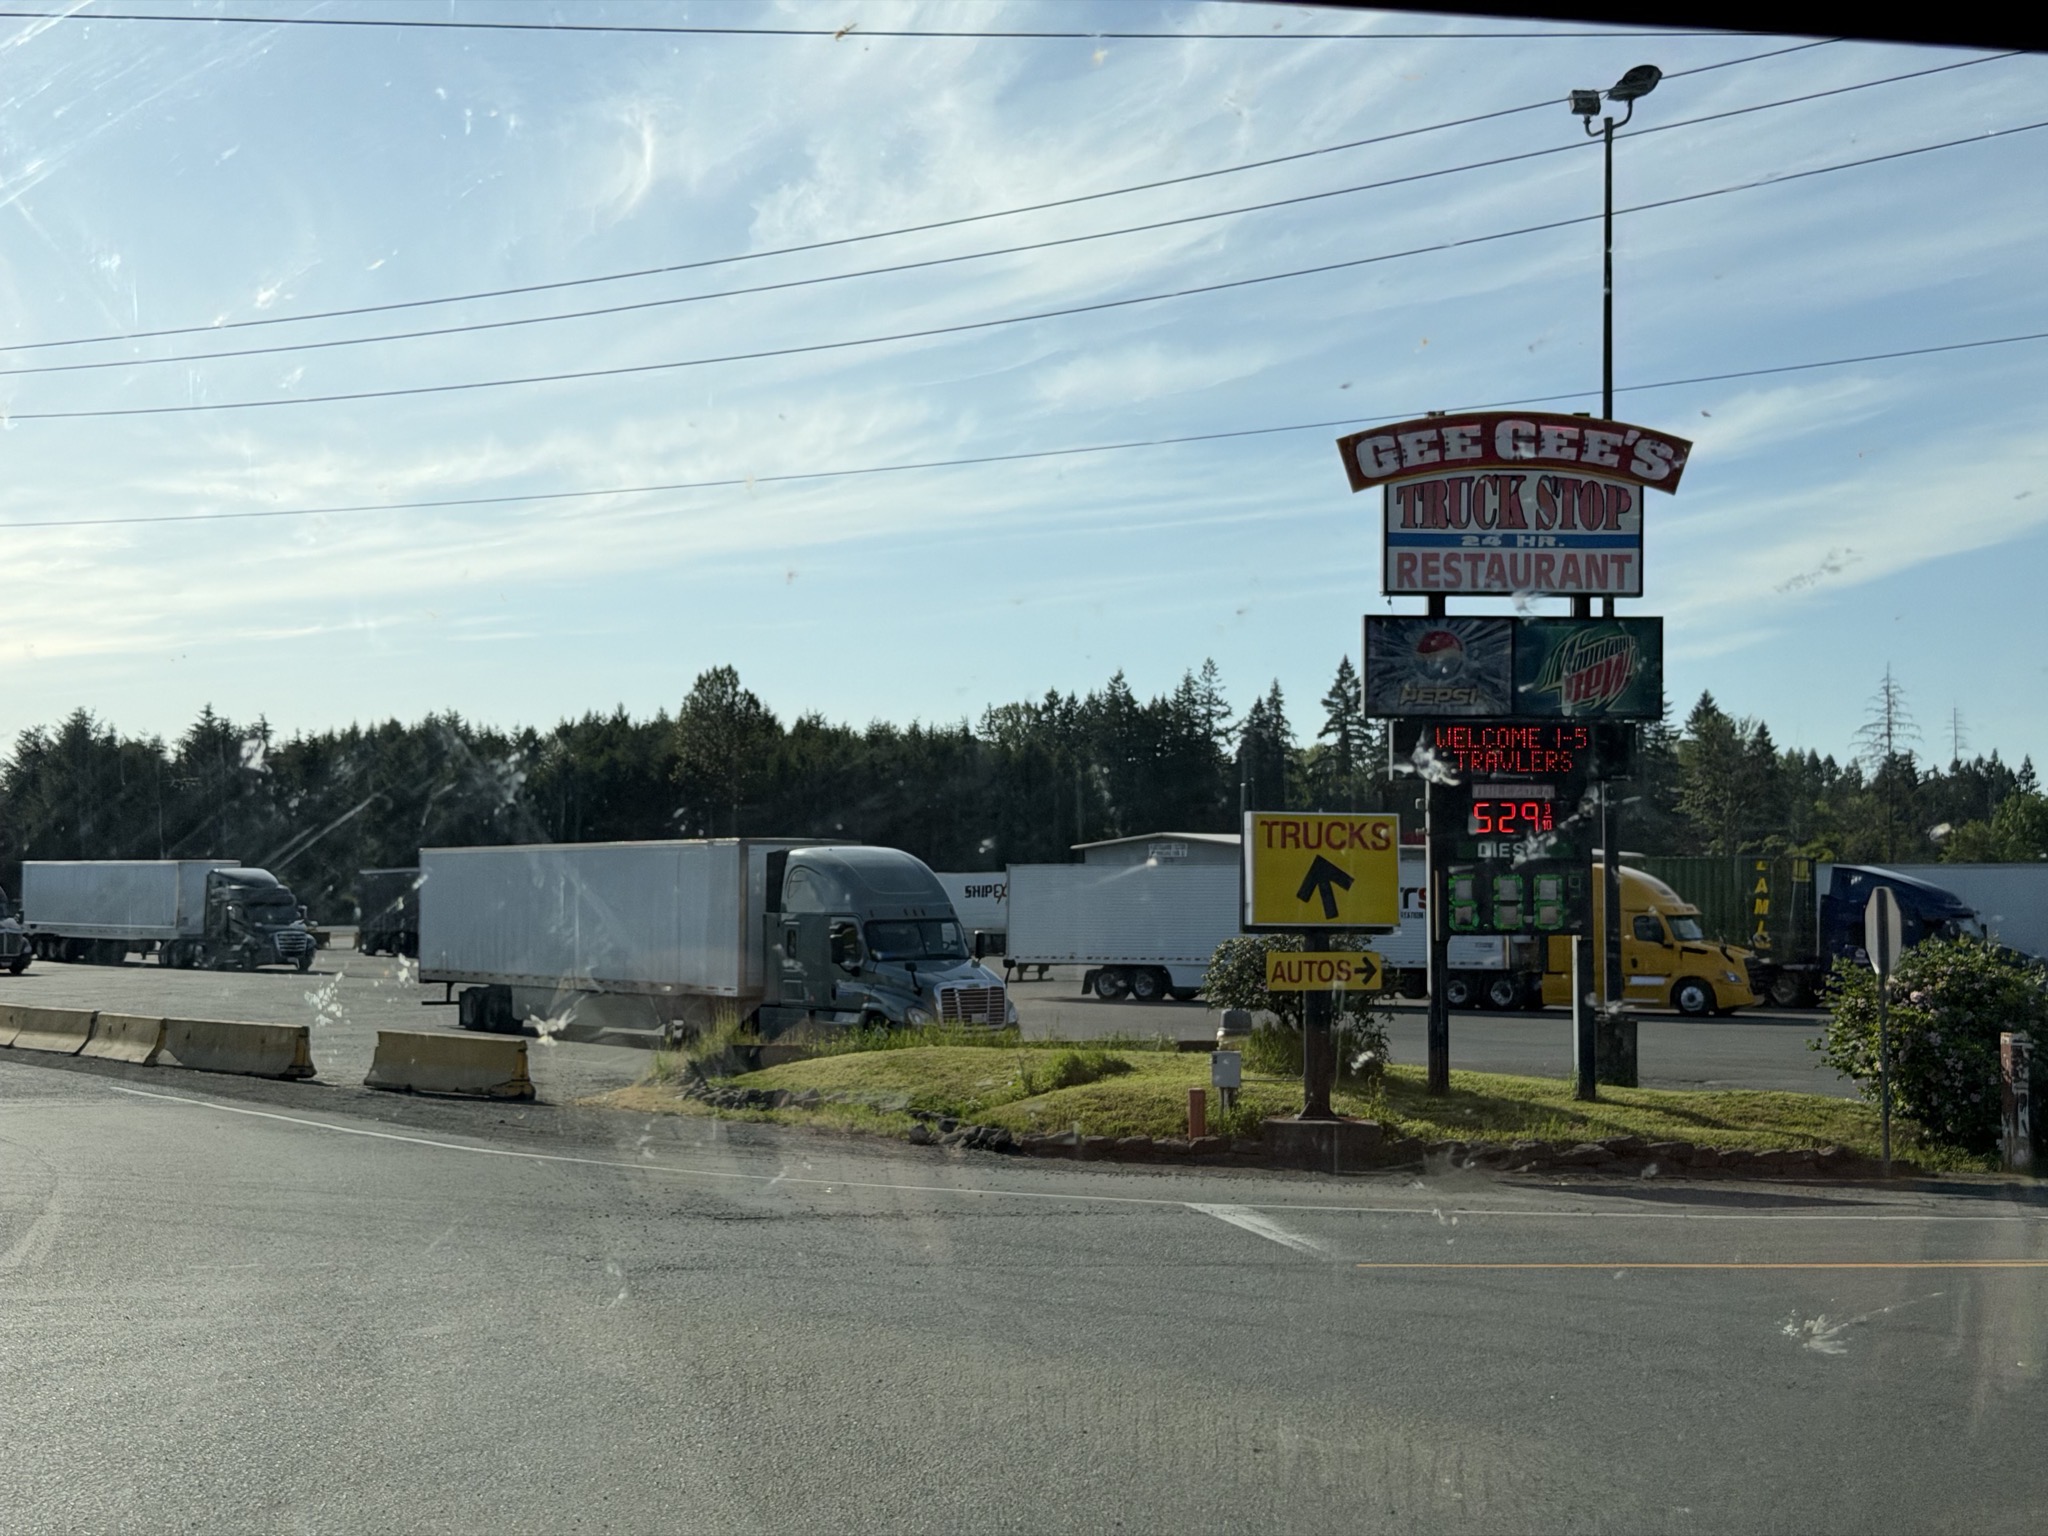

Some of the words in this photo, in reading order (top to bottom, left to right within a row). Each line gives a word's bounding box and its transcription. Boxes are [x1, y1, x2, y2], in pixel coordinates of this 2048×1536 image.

[1356, 424, 1482, 478] GEE
[1495, 420, 1674, 480] GEE'S
[1396, 474, 1528, 530] TRUCK
[1535, 475, 1632, 531] STOP
[1461, 535, 1502, 547] 24
[1516, 535, 1565, 547] HR.
[1396, 552, 1632, 590] RESTAURANT
[1400, 687, 1479, 705] PEPSI
[1436, 727, 1541, 748] WELCOME
[1557, 727, 1587, 748] I-5
[1453, 751, 1572, 772] TRAVLERS
[1473, 802, 1538, 832] 529
[1260, 820, 1391, 850] TRUCKS
[1478, 842, 1551, 858] DIESL
[1270, 959, 1352, 983] AUTOS
